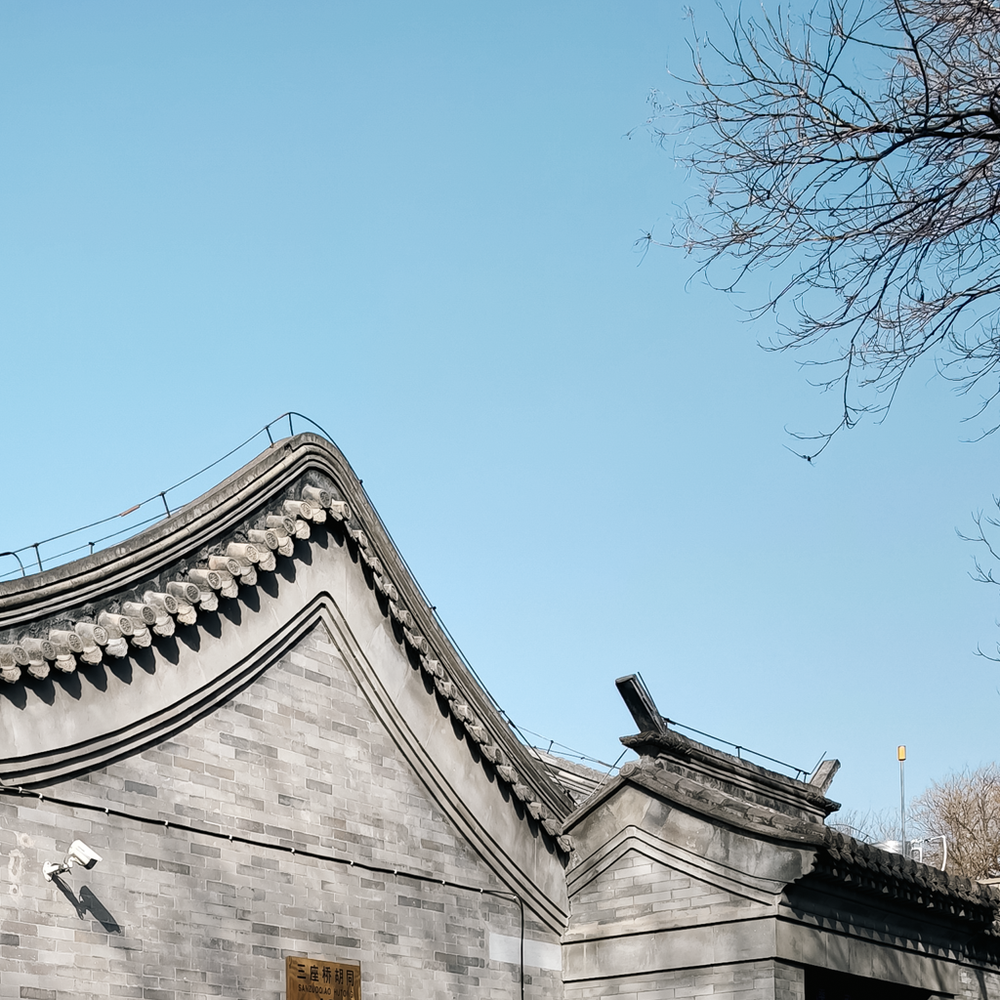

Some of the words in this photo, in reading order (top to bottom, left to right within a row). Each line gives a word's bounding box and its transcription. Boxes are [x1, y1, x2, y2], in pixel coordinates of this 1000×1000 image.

[297, 964, 354, 986] 三座桥胡同
[298, 984, 332, 995] SANZUOQIAO
